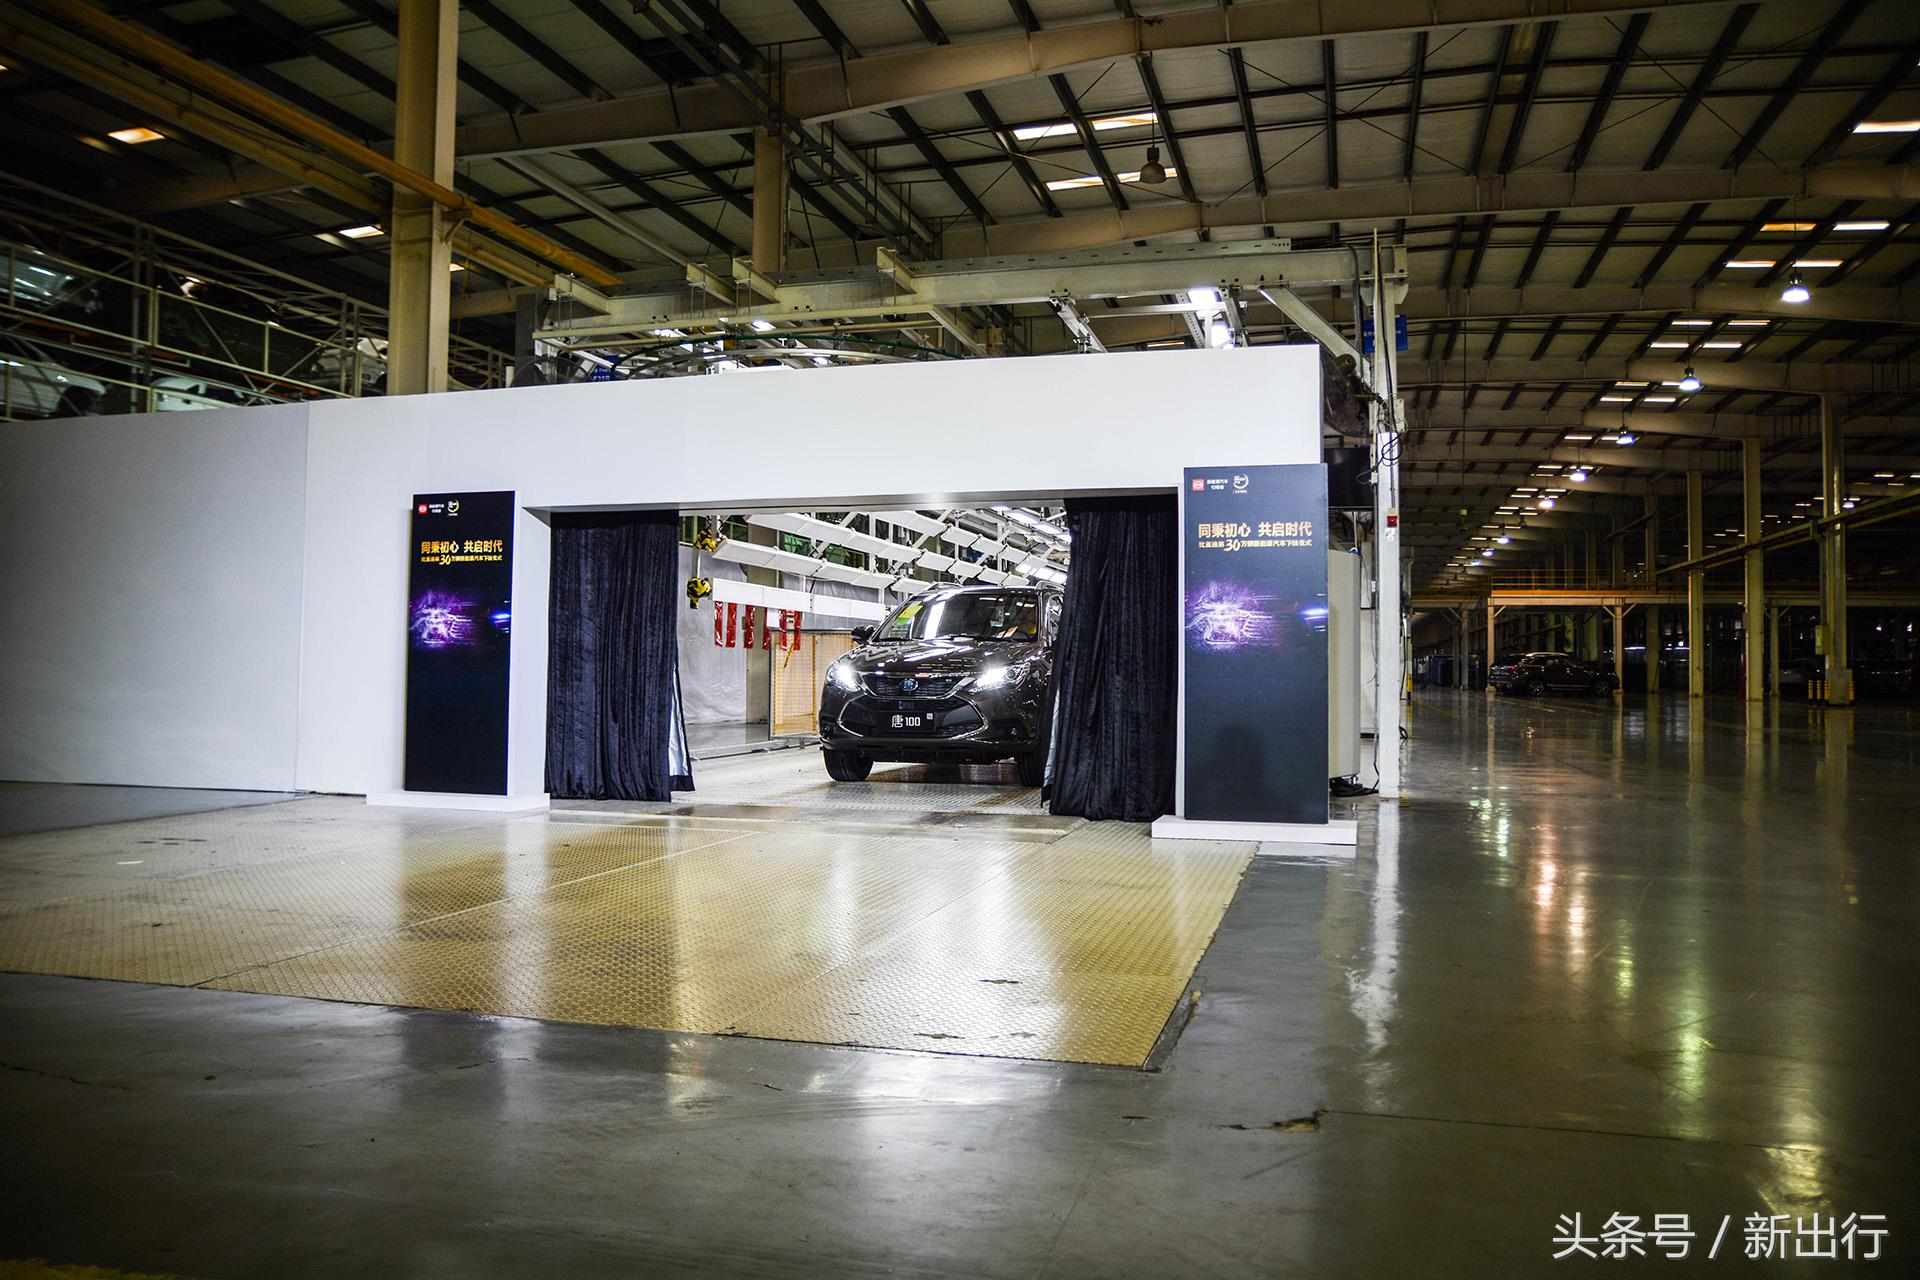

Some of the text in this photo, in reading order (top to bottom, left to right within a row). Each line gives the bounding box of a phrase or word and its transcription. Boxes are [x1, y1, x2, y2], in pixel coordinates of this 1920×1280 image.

[1198, 521, 1313, 538] 同秉初心 共启时代
[421, 540, 503, 554] 同秉初心 共启时代
